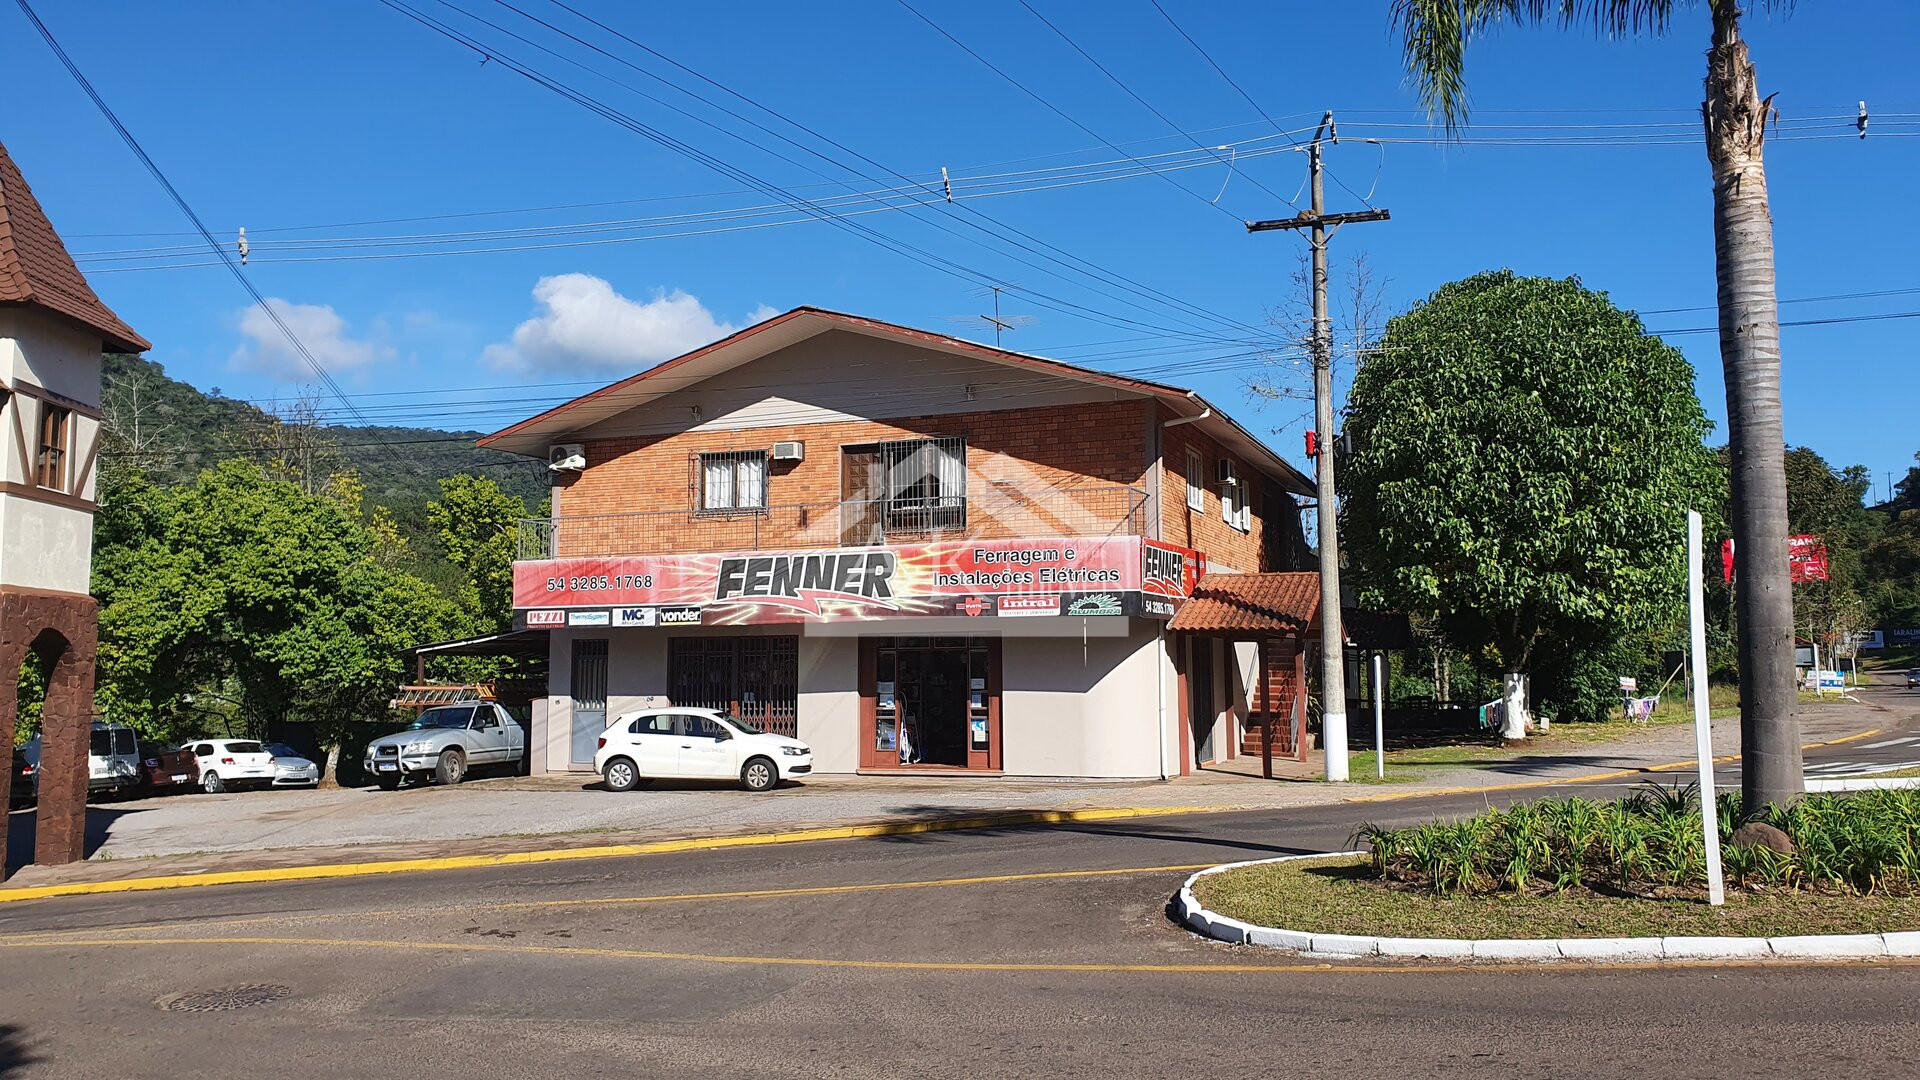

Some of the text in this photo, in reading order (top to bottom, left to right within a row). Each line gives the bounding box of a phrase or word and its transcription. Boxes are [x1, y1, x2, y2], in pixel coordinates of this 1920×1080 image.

[974, 548, 1059, 566] Ferragem
[1064, 548, 1076, 560] e
[715, 551, 896, 601] FENNER
[1145, 545, 1183, 589] FENNER
[547, 574, 653, 592] 54 3285.1768
[933, 566, 1121, 588] Instalações Elétricas
[1002, 599, 1055, 609] intral
[1070, 607, 1122, 616] ALUMBRA
[529, 611, 564, 623] PEZZI
[622, 608, 645, 621] MG
